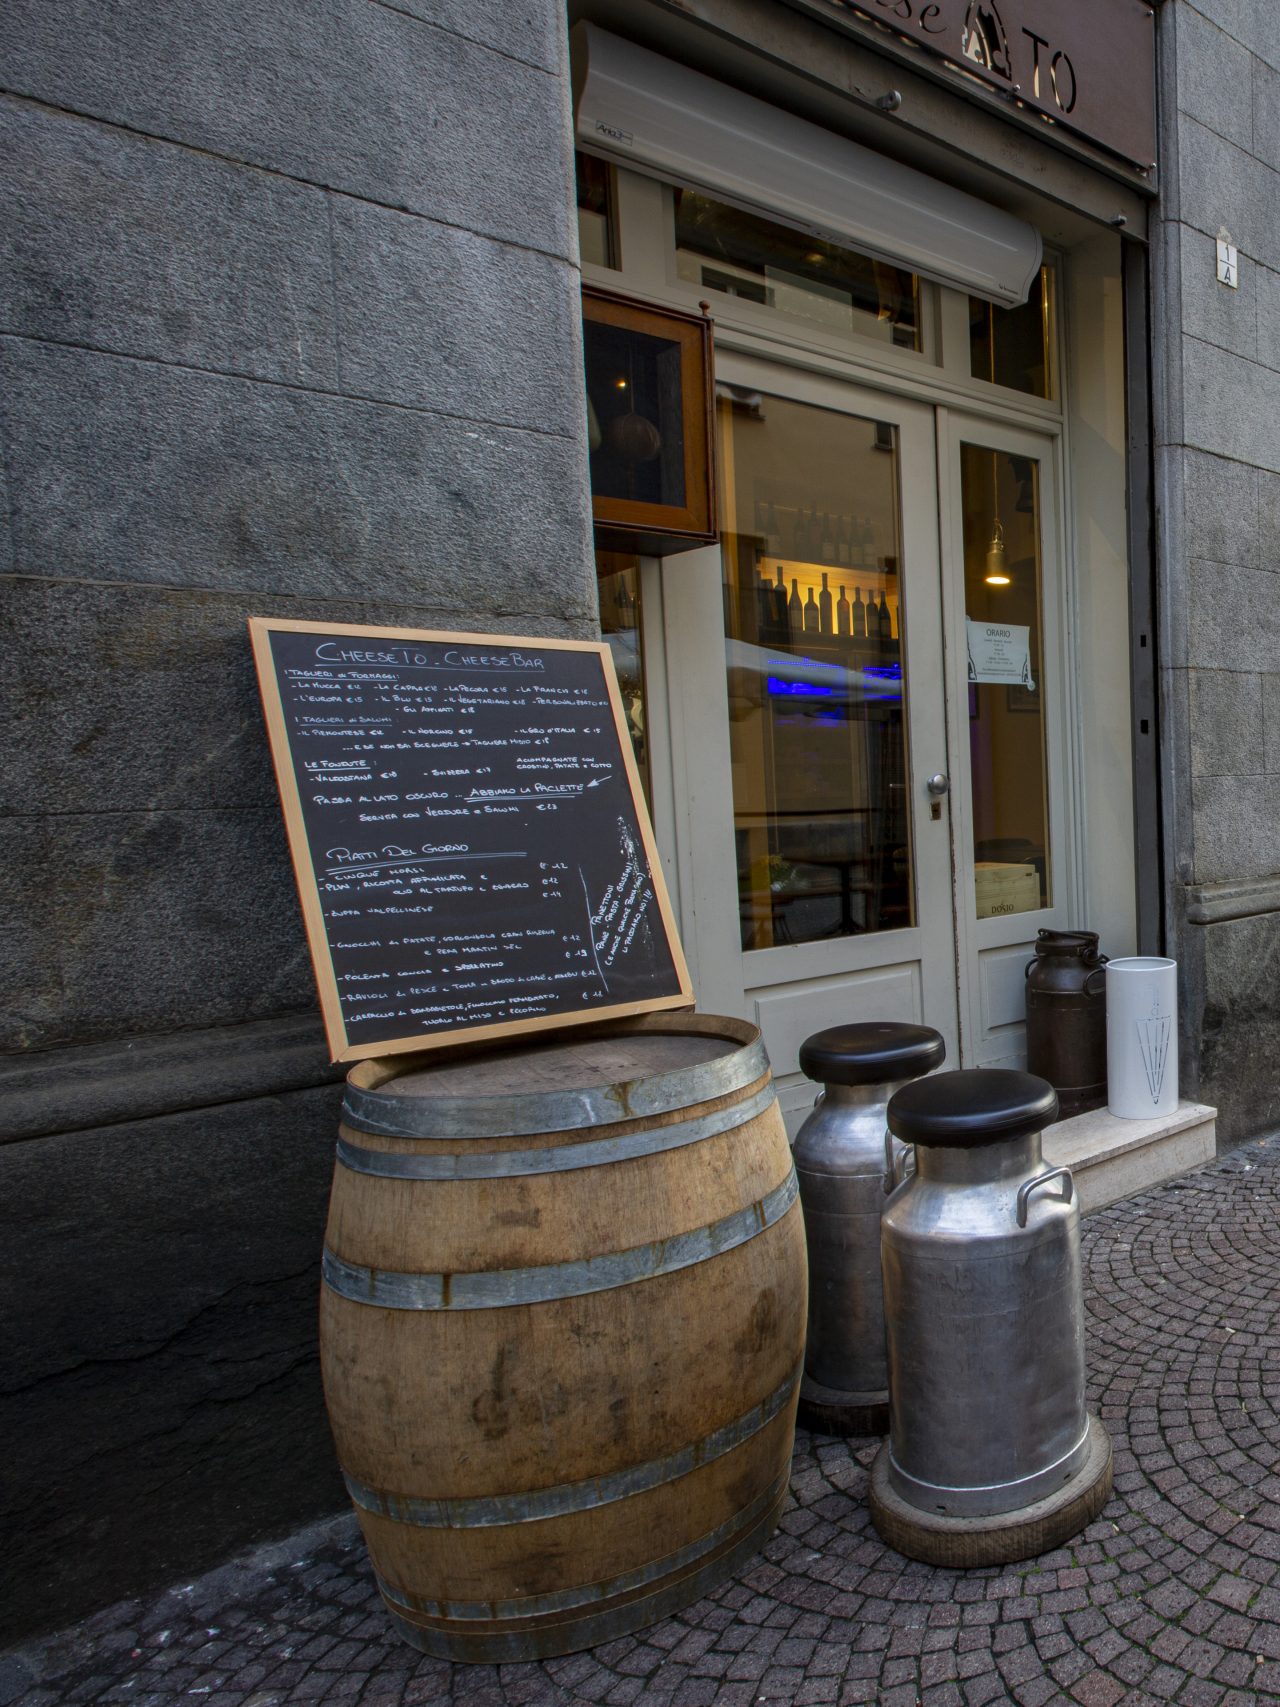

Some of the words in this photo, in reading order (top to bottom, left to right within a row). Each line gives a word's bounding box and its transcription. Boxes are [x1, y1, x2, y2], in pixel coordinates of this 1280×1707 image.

[1022, 26, 1076, 114] TO
[1225, 244, 1230, 262] 1
[1224, 266, 1231, 283] A
[986, 628, 1011, 639] ORARIO
